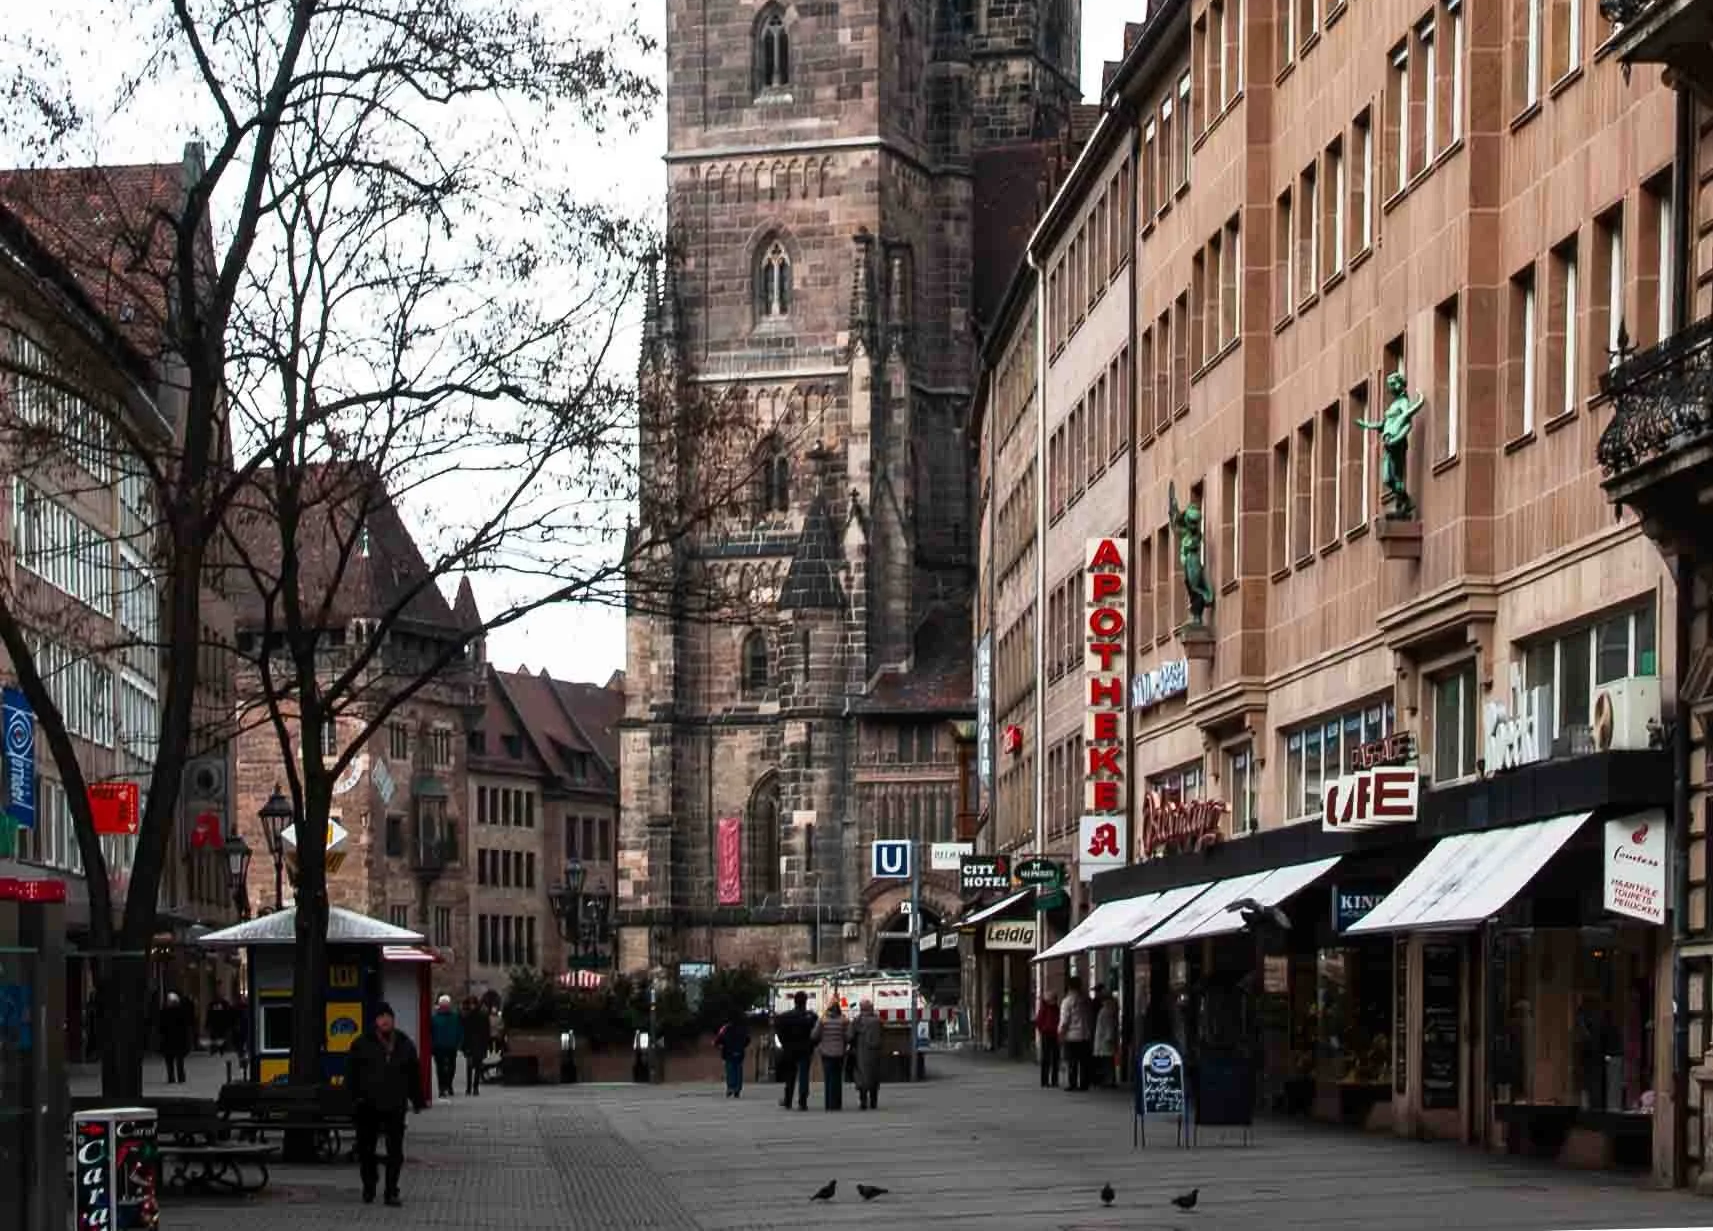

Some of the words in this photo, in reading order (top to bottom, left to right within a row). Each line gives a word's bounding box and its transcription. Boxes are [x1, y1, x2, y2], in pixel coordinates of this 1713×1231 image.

[1089, 539, 1124, 811] APOTHEKE
[881, 846, 902, 873] U
[963, 864, 995, 876] CITY
[963, 876, 1009, 888] HOTEL
[987, 927, 1034, 944] Leidig
[78, 1139, 109, 1231] Cara
